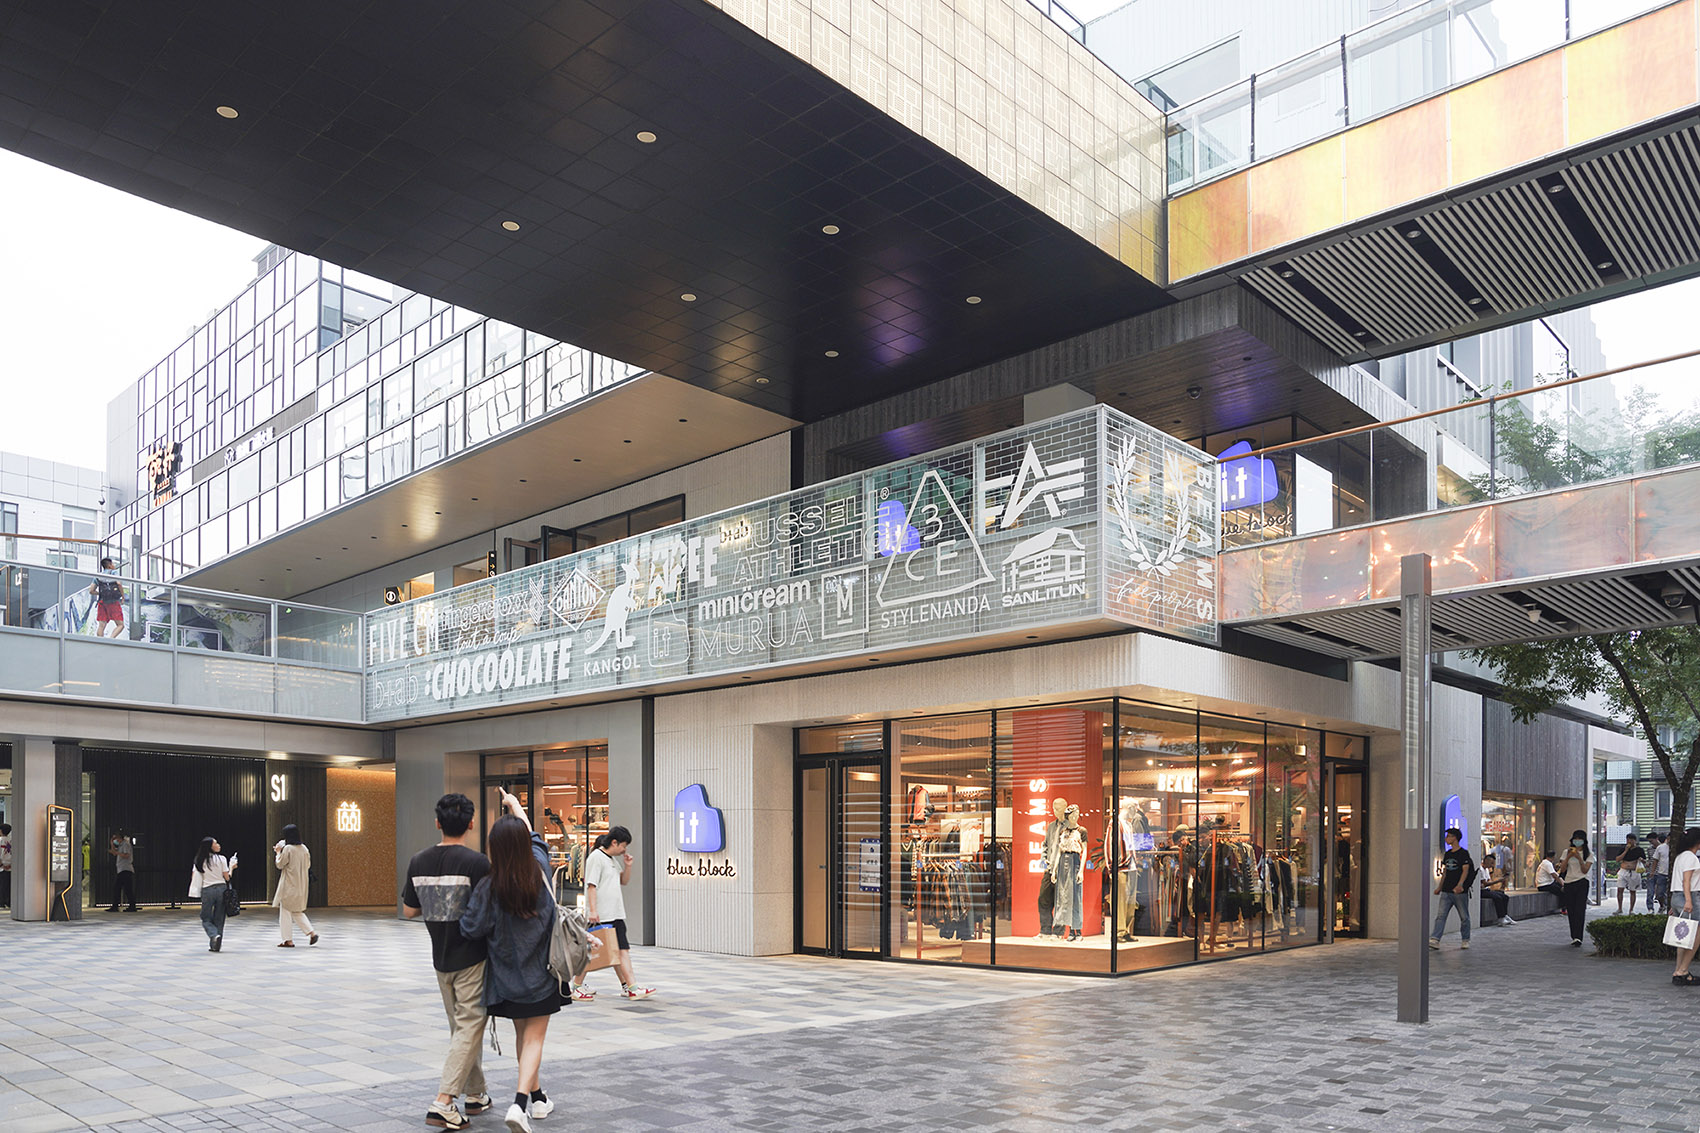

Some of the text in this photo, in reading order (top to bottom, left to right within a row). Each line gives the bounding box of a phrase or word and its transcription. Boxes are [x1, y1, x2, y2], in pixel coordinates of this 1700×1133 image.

[1221, 466, 1248, 503] i.t
[921, 504, 943, 540] 3
[733, 523, 889, 585] ATHLETIC
[1196, 465, 1214, 620] BEAMS
[556, 573, 597, 612] DANTON
[880, 593, 991, 629] STYLENANDA
[1002, 581, 1086, 608] SANLITUN
[441, 591, 528, 632] fingercroxx
[369, 604, 439, 666] FIVE CM
[699, 607, 814, 660] MURUA
[583, 653, 641, 678] KANGOL
[372, 664, 419, 710] b+ab
[270, 774, 286, 802] S1
[679, 811, 699, 844] i.t
[667, 857, 736, 877] blue block
